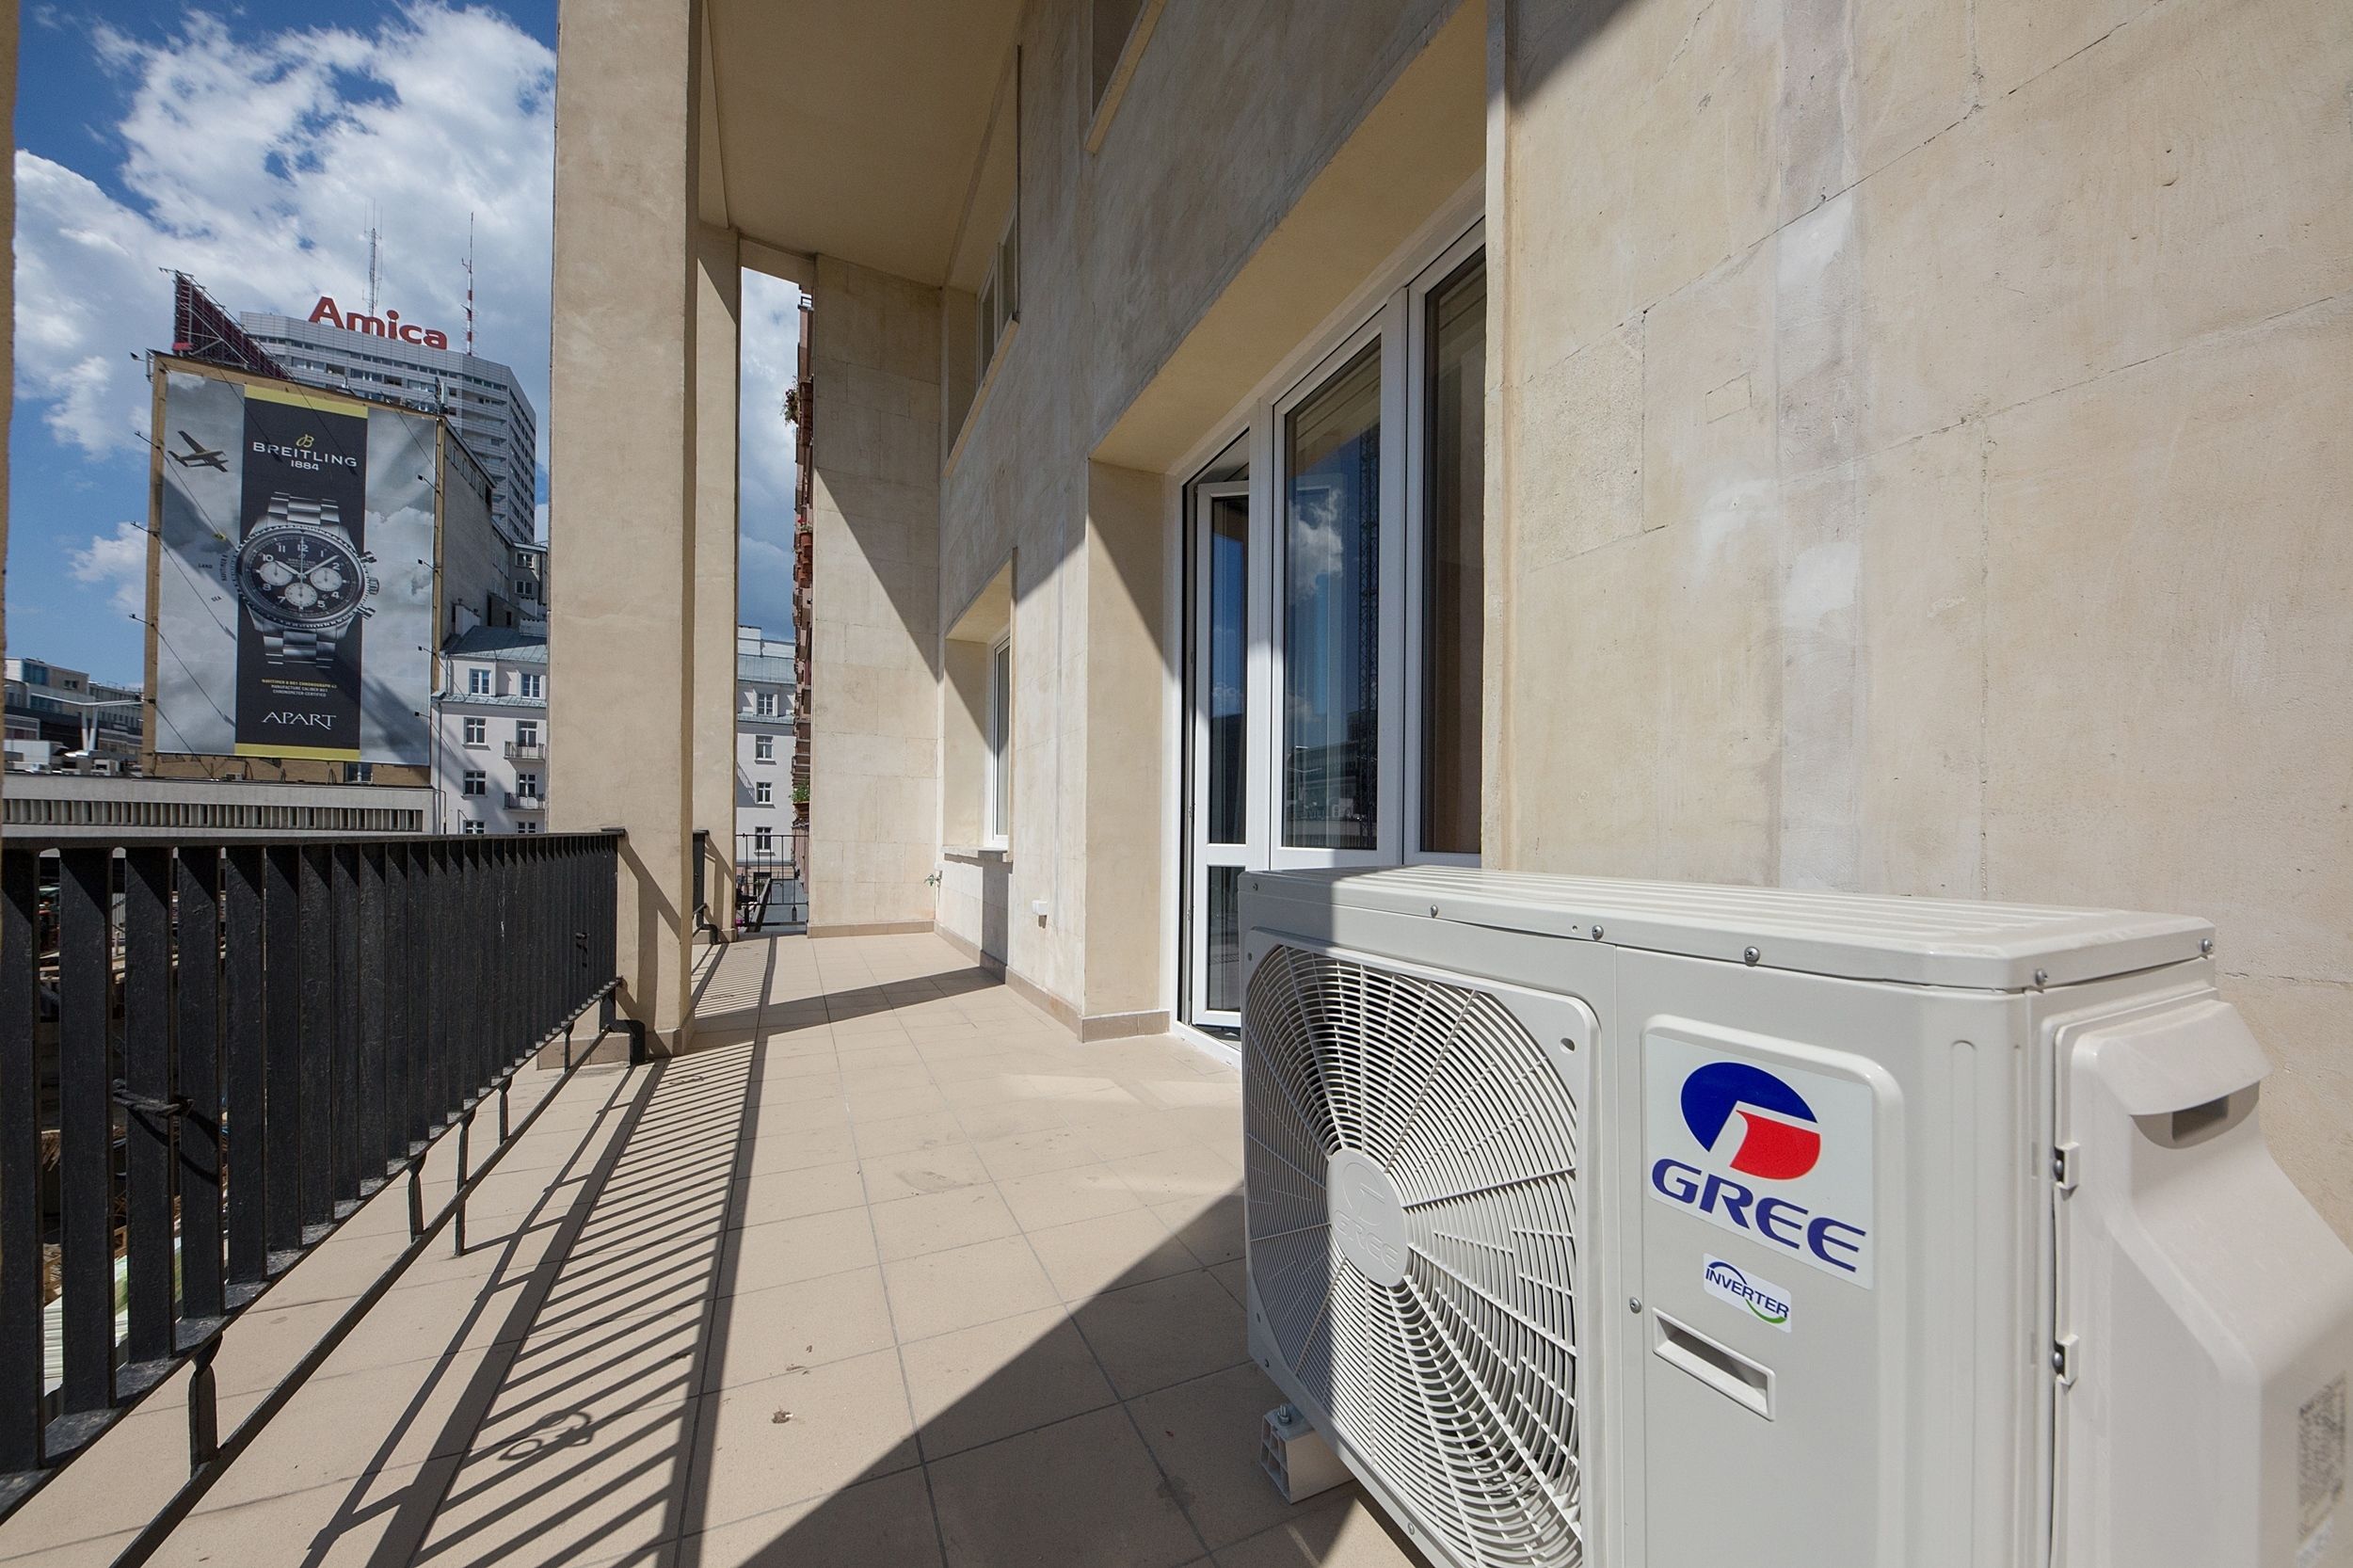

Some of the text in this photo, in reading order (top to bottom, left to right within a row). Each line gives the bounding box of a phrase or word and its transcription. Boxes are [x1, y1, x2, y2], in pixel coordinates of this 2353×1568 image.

[309, 296, 447, 350] Amica
[253, 441, 357, 467] BREITLING
[291, 460, 319, 472] 1884
[297, 544, 309, 552] 12
[332, 562, 340, 570] 2
[278, 595, 285, 603] 7
[331, 591, 340, 600] 4
[262, 712, 337, 730] APART
[1652, 1158, 1866, 1272] GREE
[1335, 1209, 1398, 1272] GREE
[1705, 1267, 1789, 1320] INVERTER
